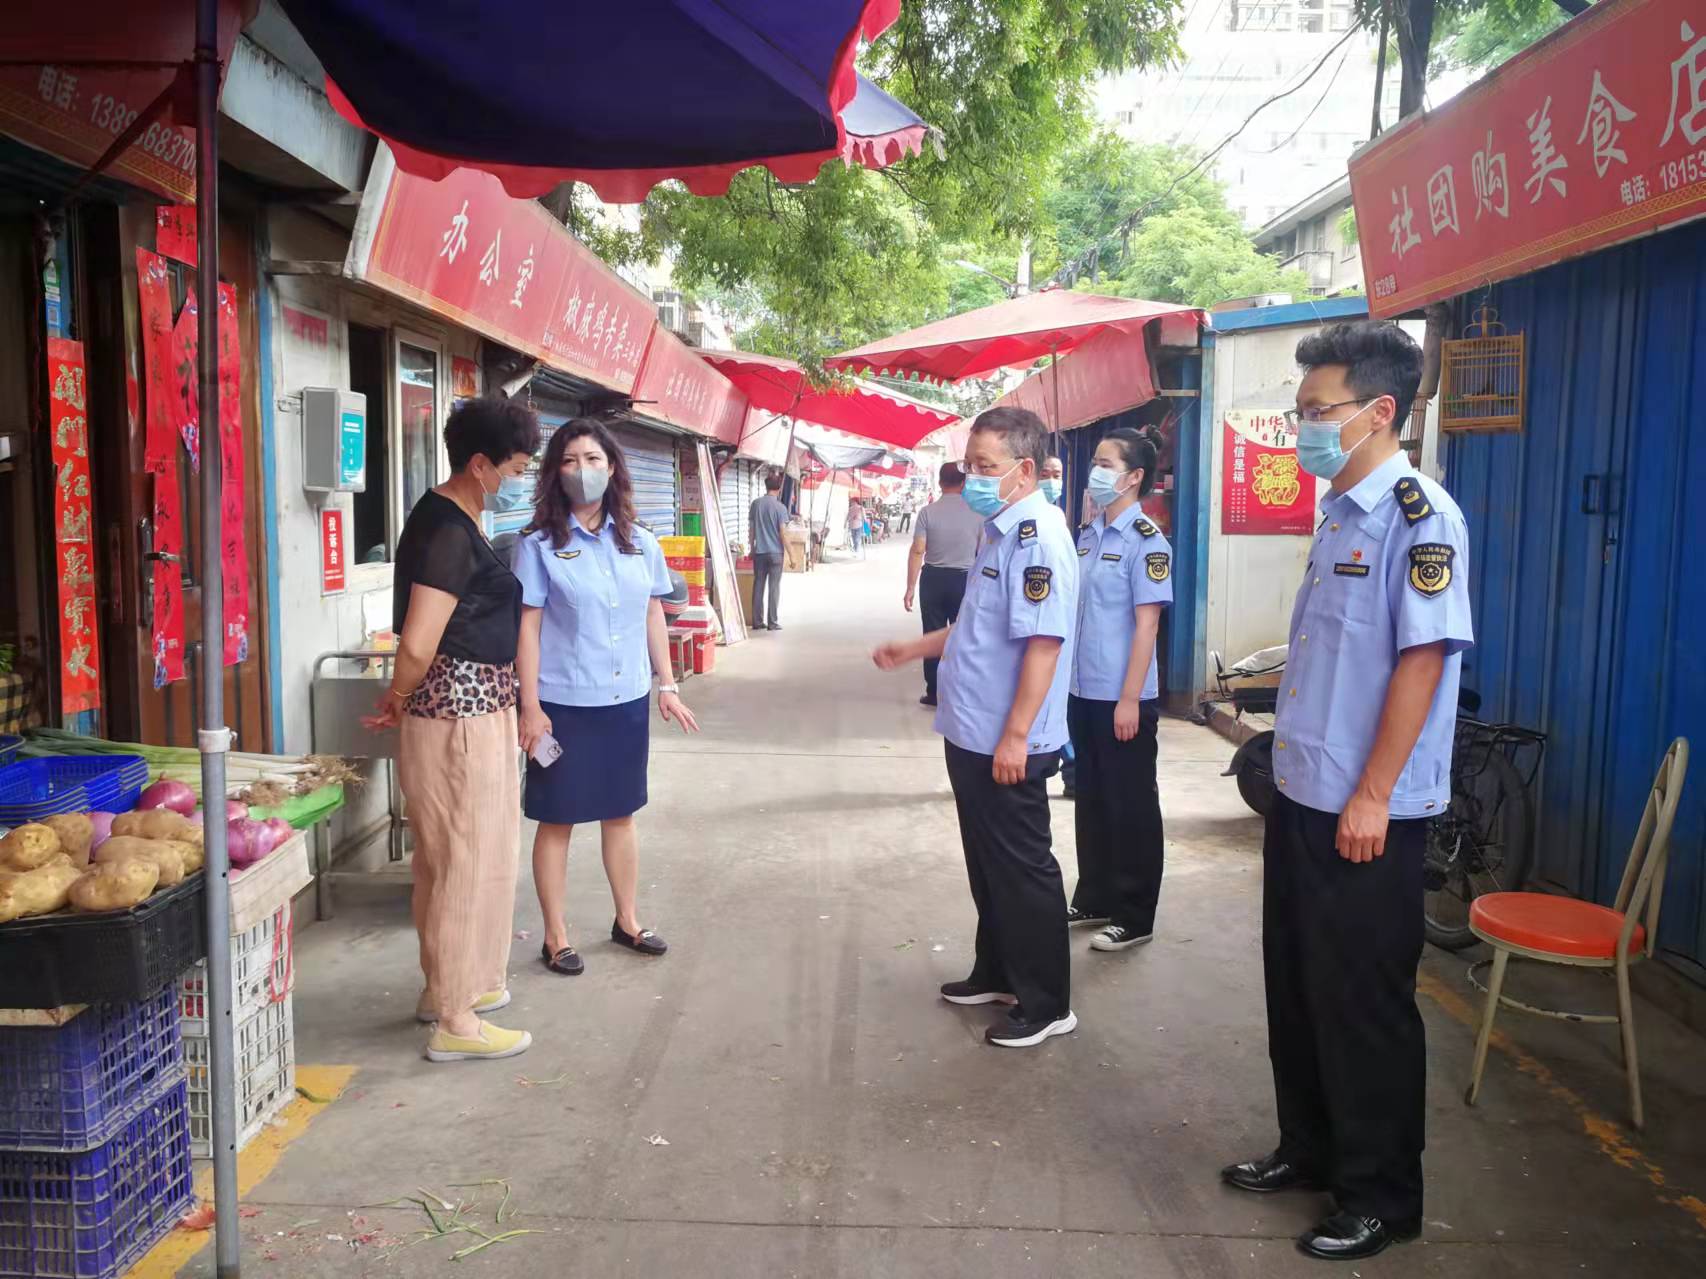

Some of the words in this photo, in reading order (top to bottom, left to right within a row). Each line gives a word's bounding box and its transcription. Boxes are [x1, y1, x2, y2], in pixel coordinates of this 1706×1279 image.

[1386, 19, 1706, 262] 社团购美食店
[440, 200, 534, 309] 办公室
[1232, 434, 1247, 484] 诚信是福
